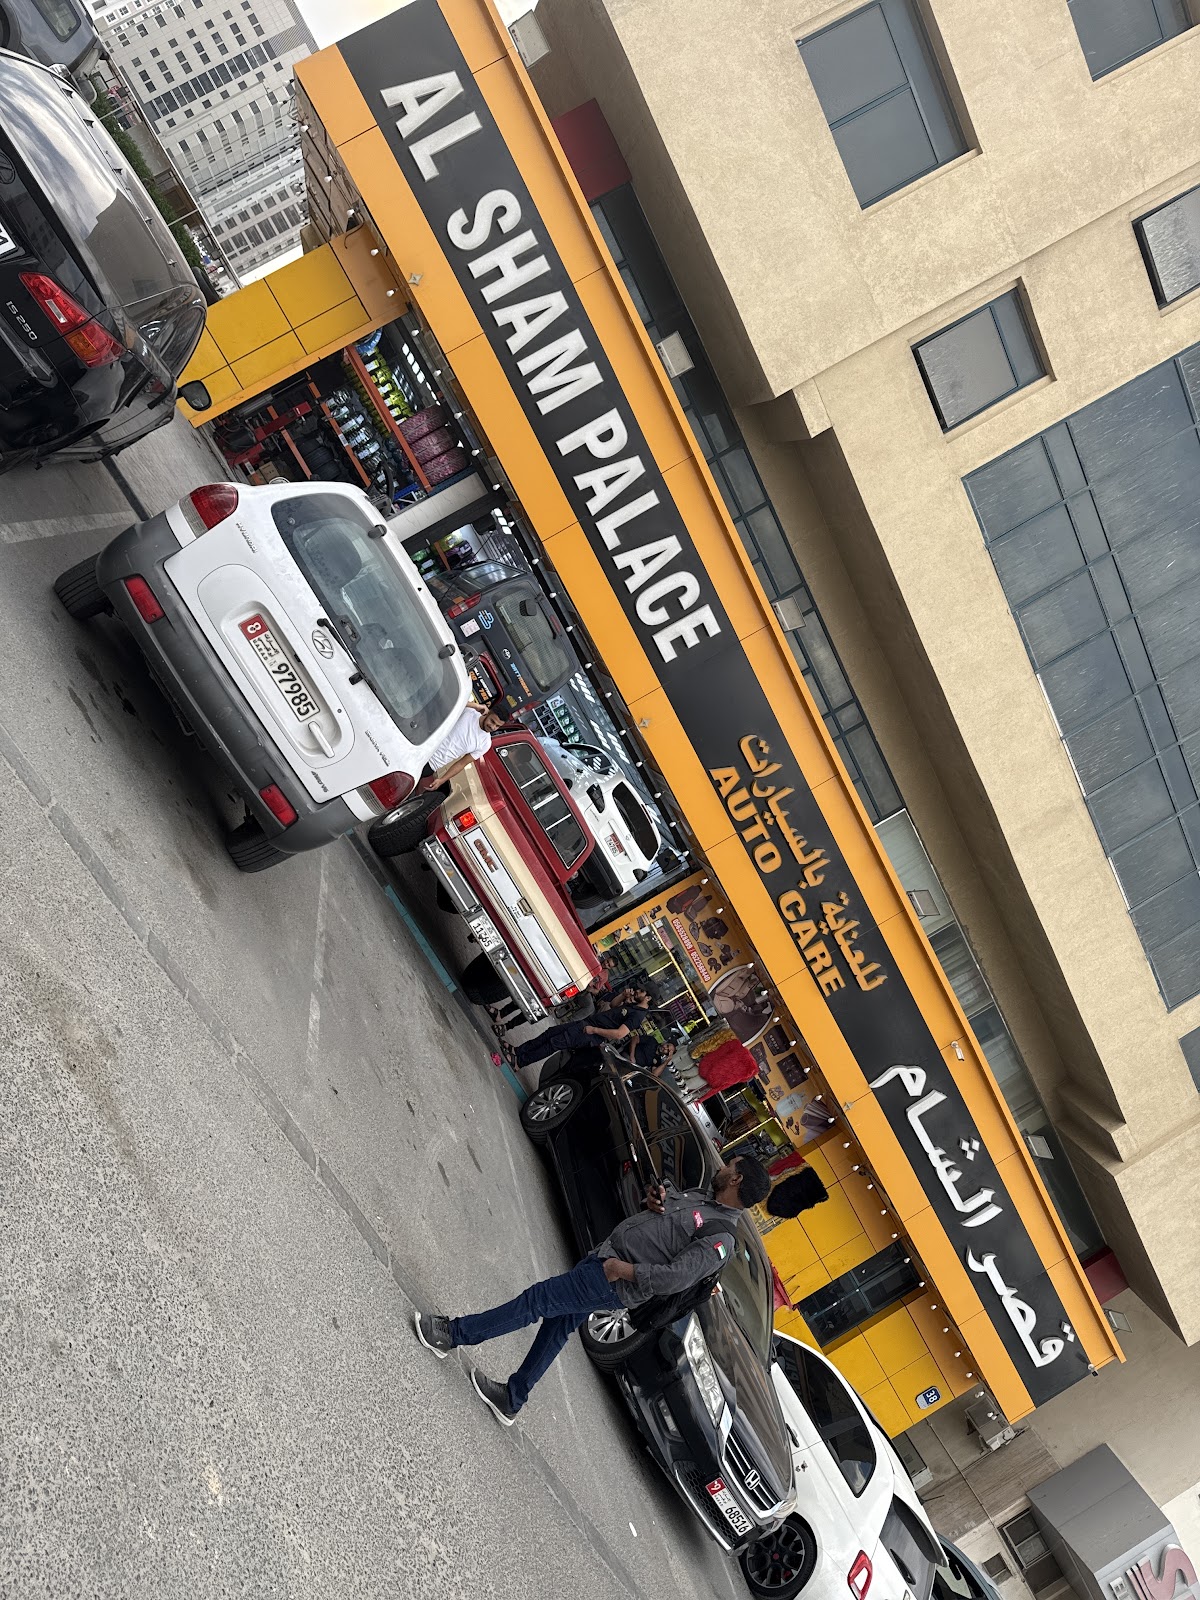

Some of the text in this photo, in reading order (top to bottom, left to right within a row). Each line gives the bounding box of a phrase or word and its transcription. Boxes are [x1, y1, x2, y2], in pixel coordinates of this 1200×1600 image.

[5, 300, 38, 341] IS 250
[379, 69, 722, 664] AL SHAM PALACE
[246, 621, 262, 634] 8
[271, 662, 316, 716] 97985
[473, 838, 499, 874] GMC
[738, 734, 888, 991] للعناية بالسيارات
[708, 766, 846, 998] AUTO CARE
[868, 1064, 1075, 1368] قصر الشام
[926, 1390, 938, 1403] 38
[725, 1506, 748, 1533] 68516
